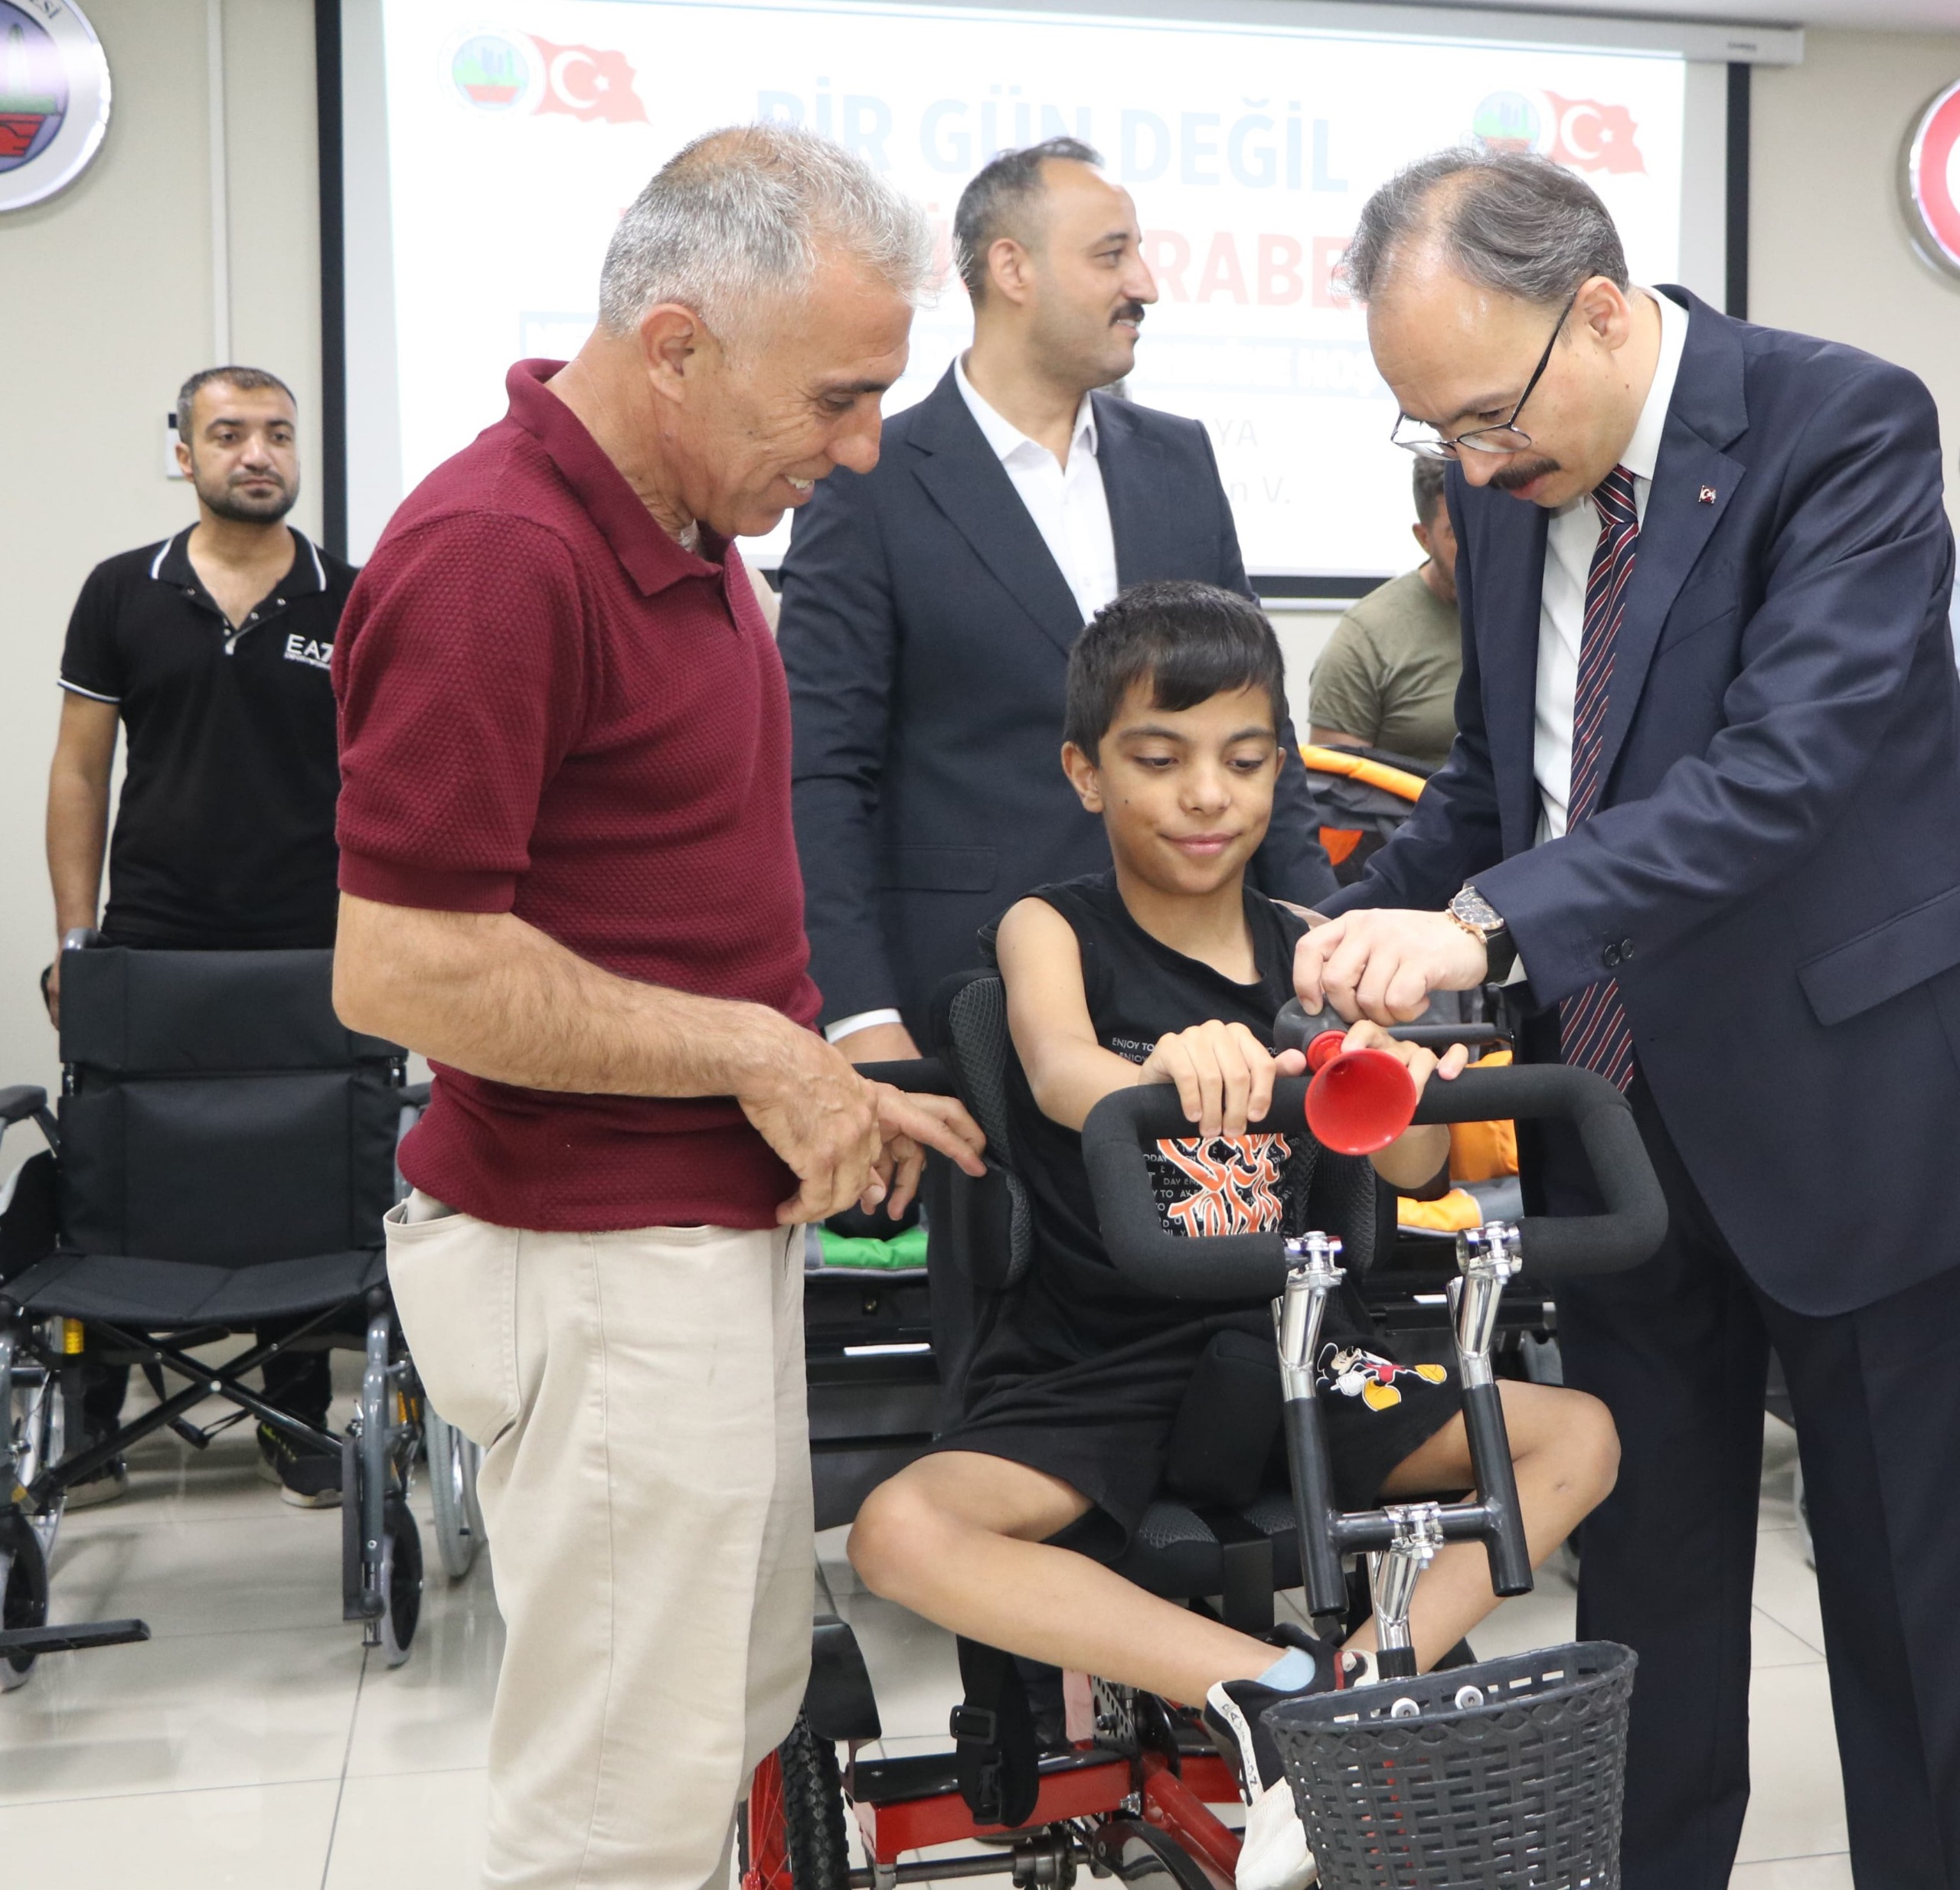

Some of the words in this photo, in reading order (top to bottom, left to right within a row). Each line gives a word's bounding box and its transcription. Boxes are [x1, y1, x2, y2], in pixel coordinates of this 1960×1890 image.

[919, 83, 1092, 175] GÜN
[1120, 96, 1349, 193] DEĞİL
[1142, 228, 1368, 310] RABE
[1262, 475, 1292, 505] V.
[286, 633, 335, 663] EA7
[1112, 1037, 1140, 1049] ENJOY
